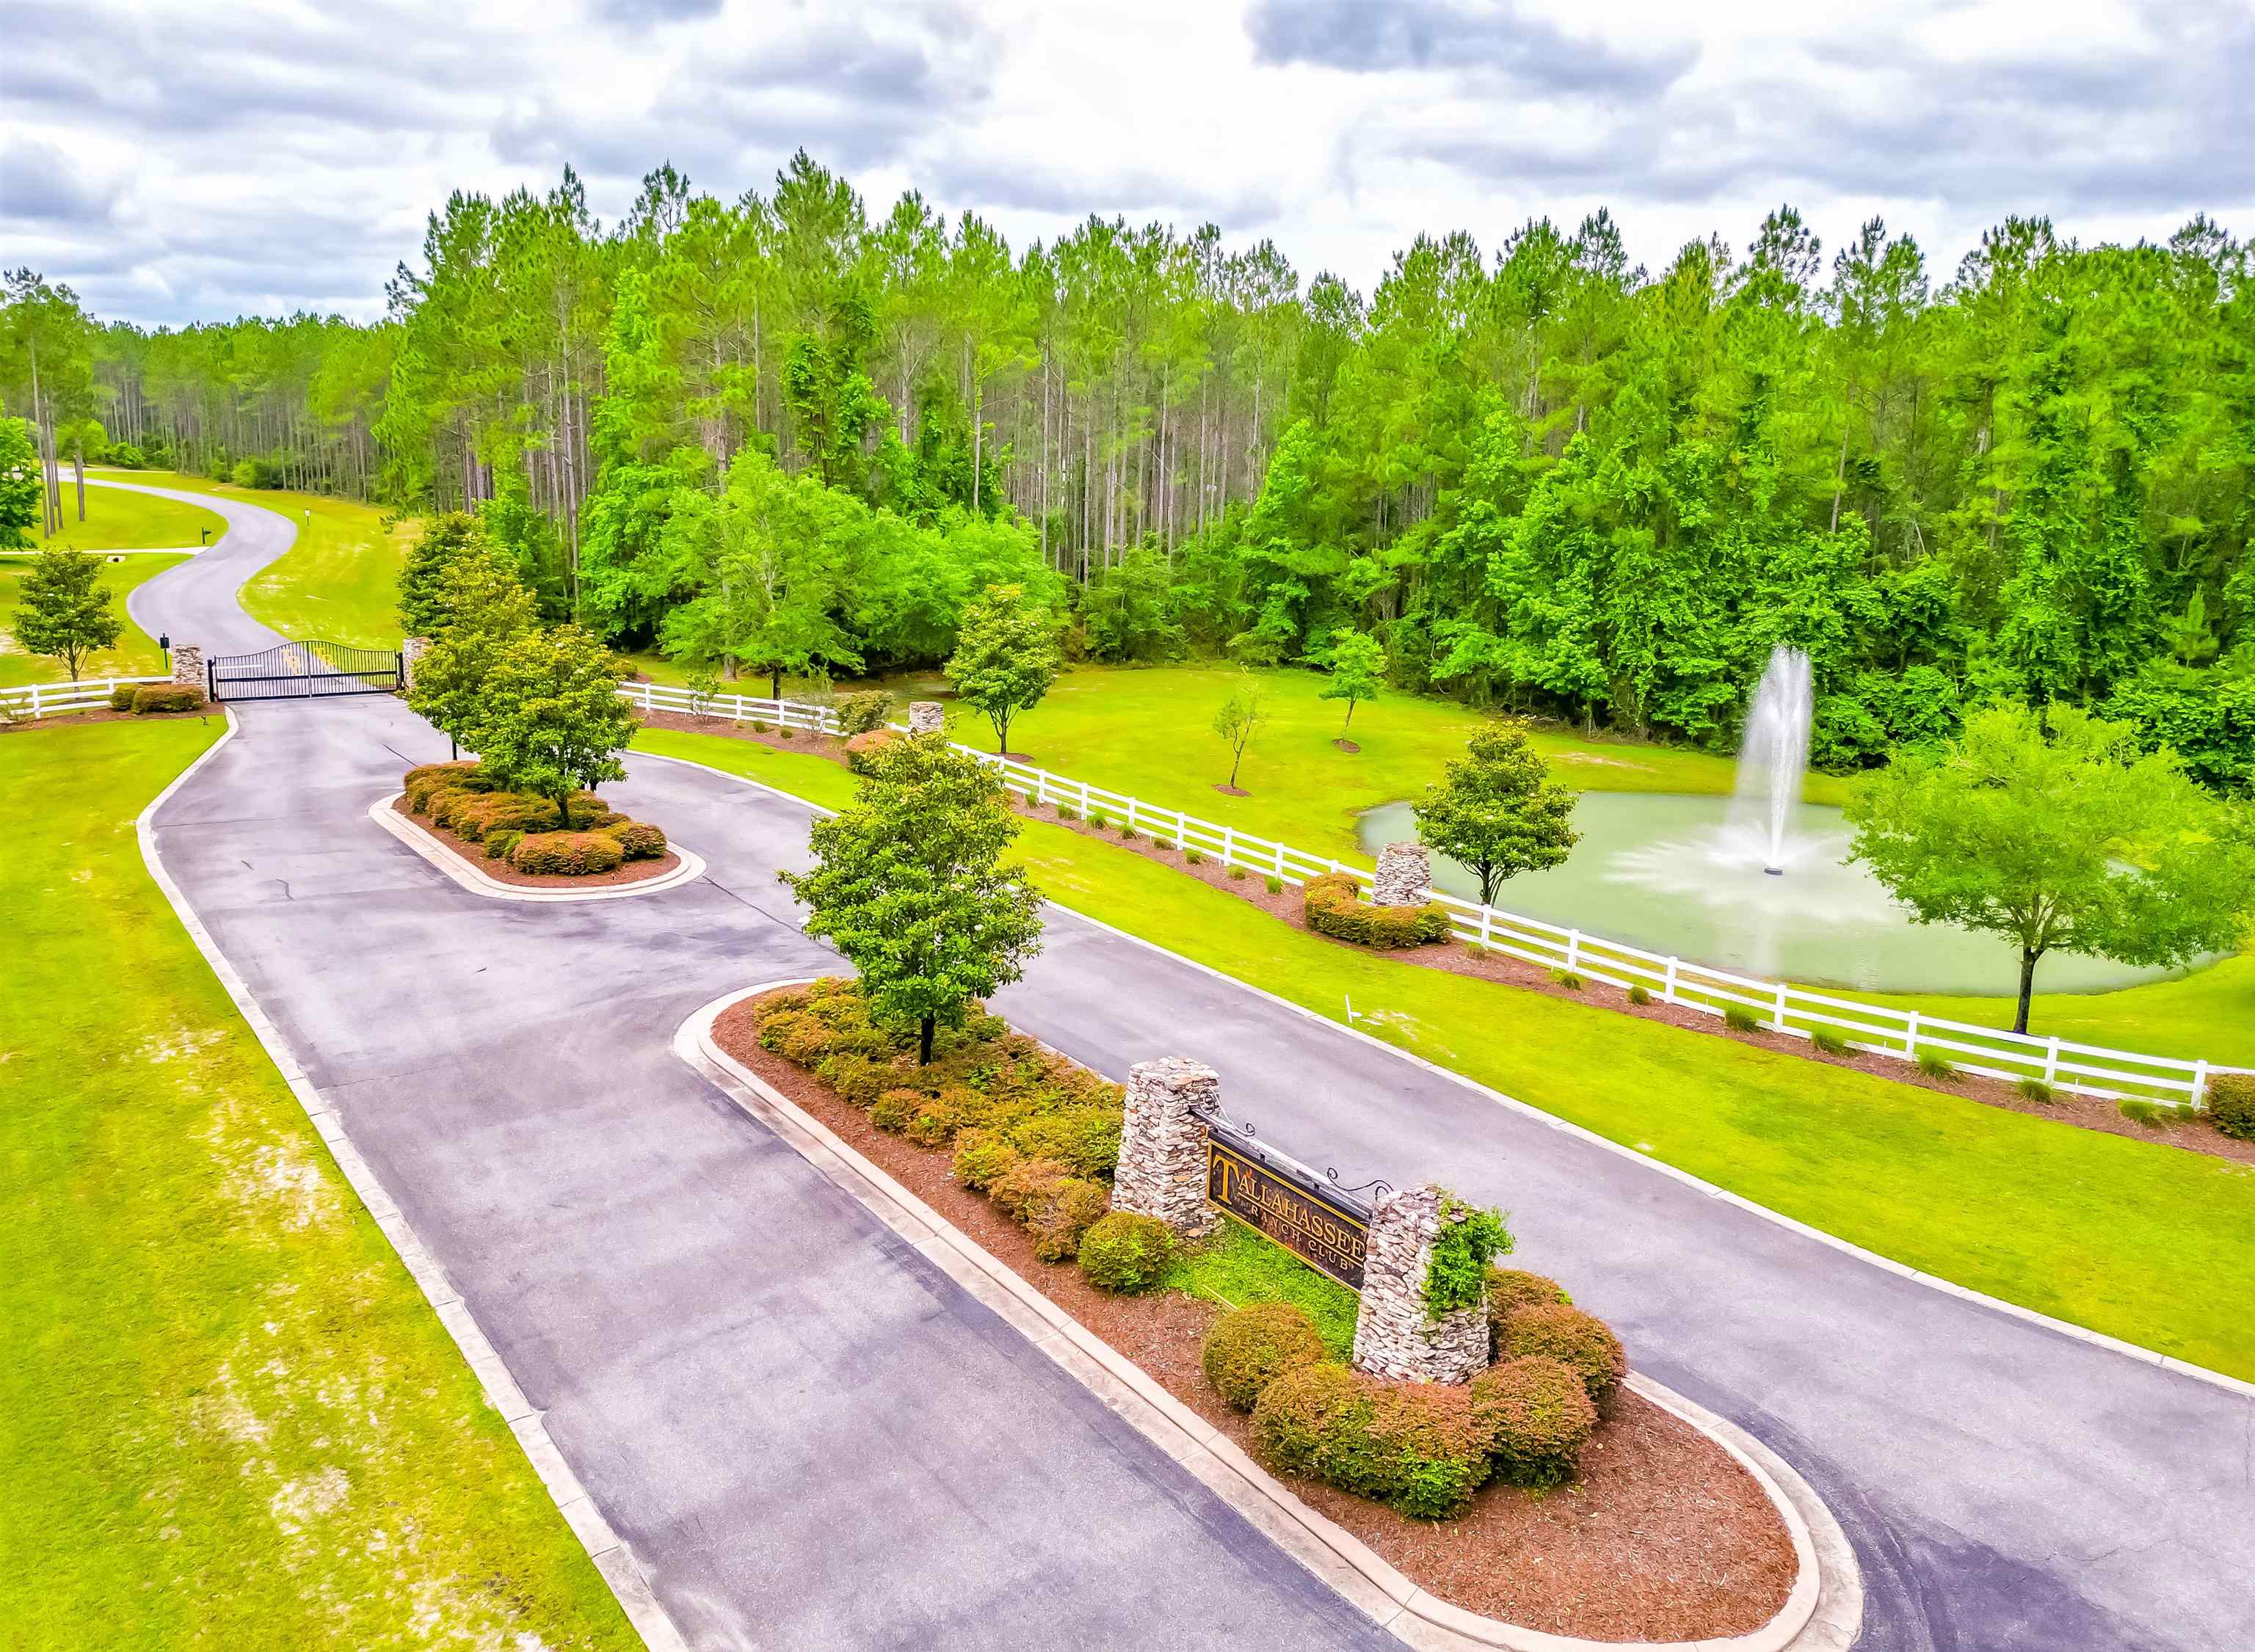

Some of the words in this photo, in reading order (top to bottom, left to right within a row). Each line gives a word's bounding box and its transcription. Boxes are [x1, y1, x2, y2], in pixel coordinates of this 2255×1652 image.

[1213, 1154, 1365, 1262] TALLAHASSEE
[1251, 1205, 1301, 1242] RANCH
[1308, 1240, 1348, 1270] CLUB
